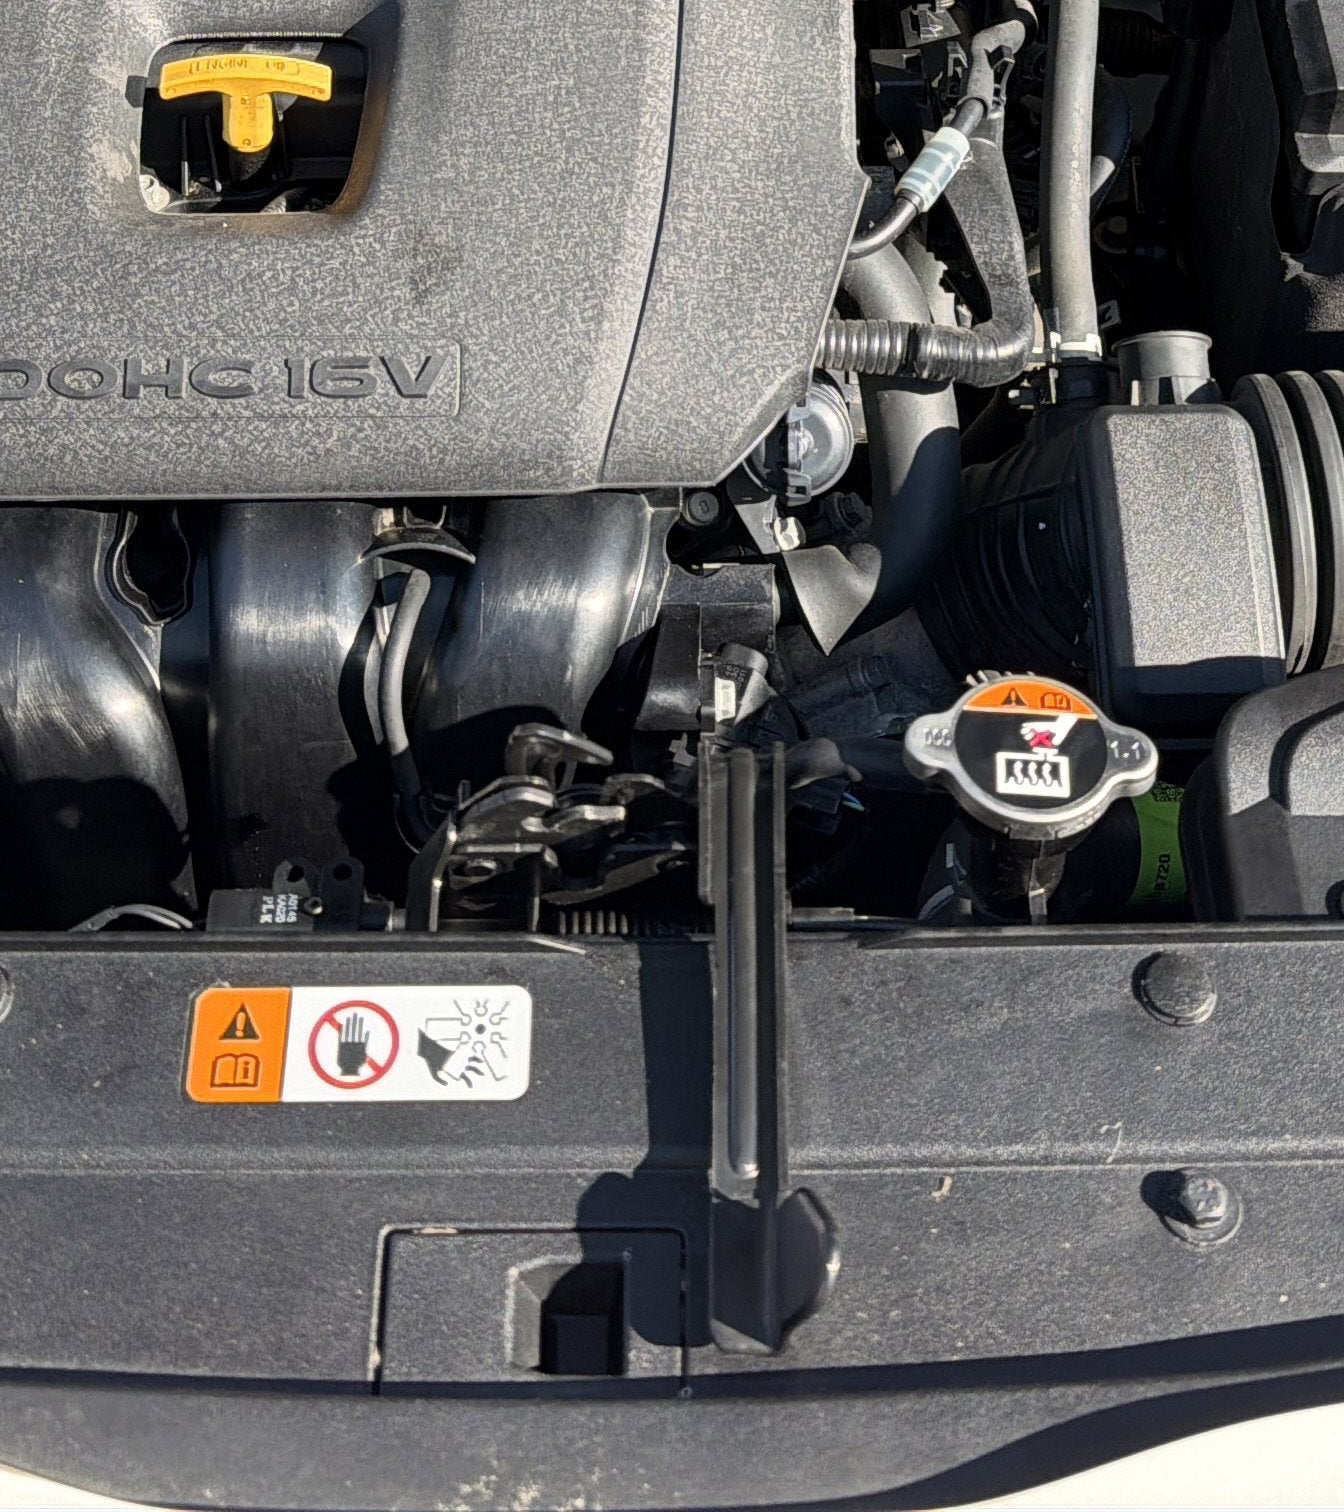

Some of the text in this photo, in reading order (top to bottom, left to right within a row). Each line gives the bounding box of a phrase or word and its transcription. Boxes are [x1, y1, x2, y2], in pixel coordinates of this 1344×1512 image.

[284, 354, 454, 400] 16V
[1110, 740, 1141, 760] 1.1
[259, 895, 275, 924] PLK
